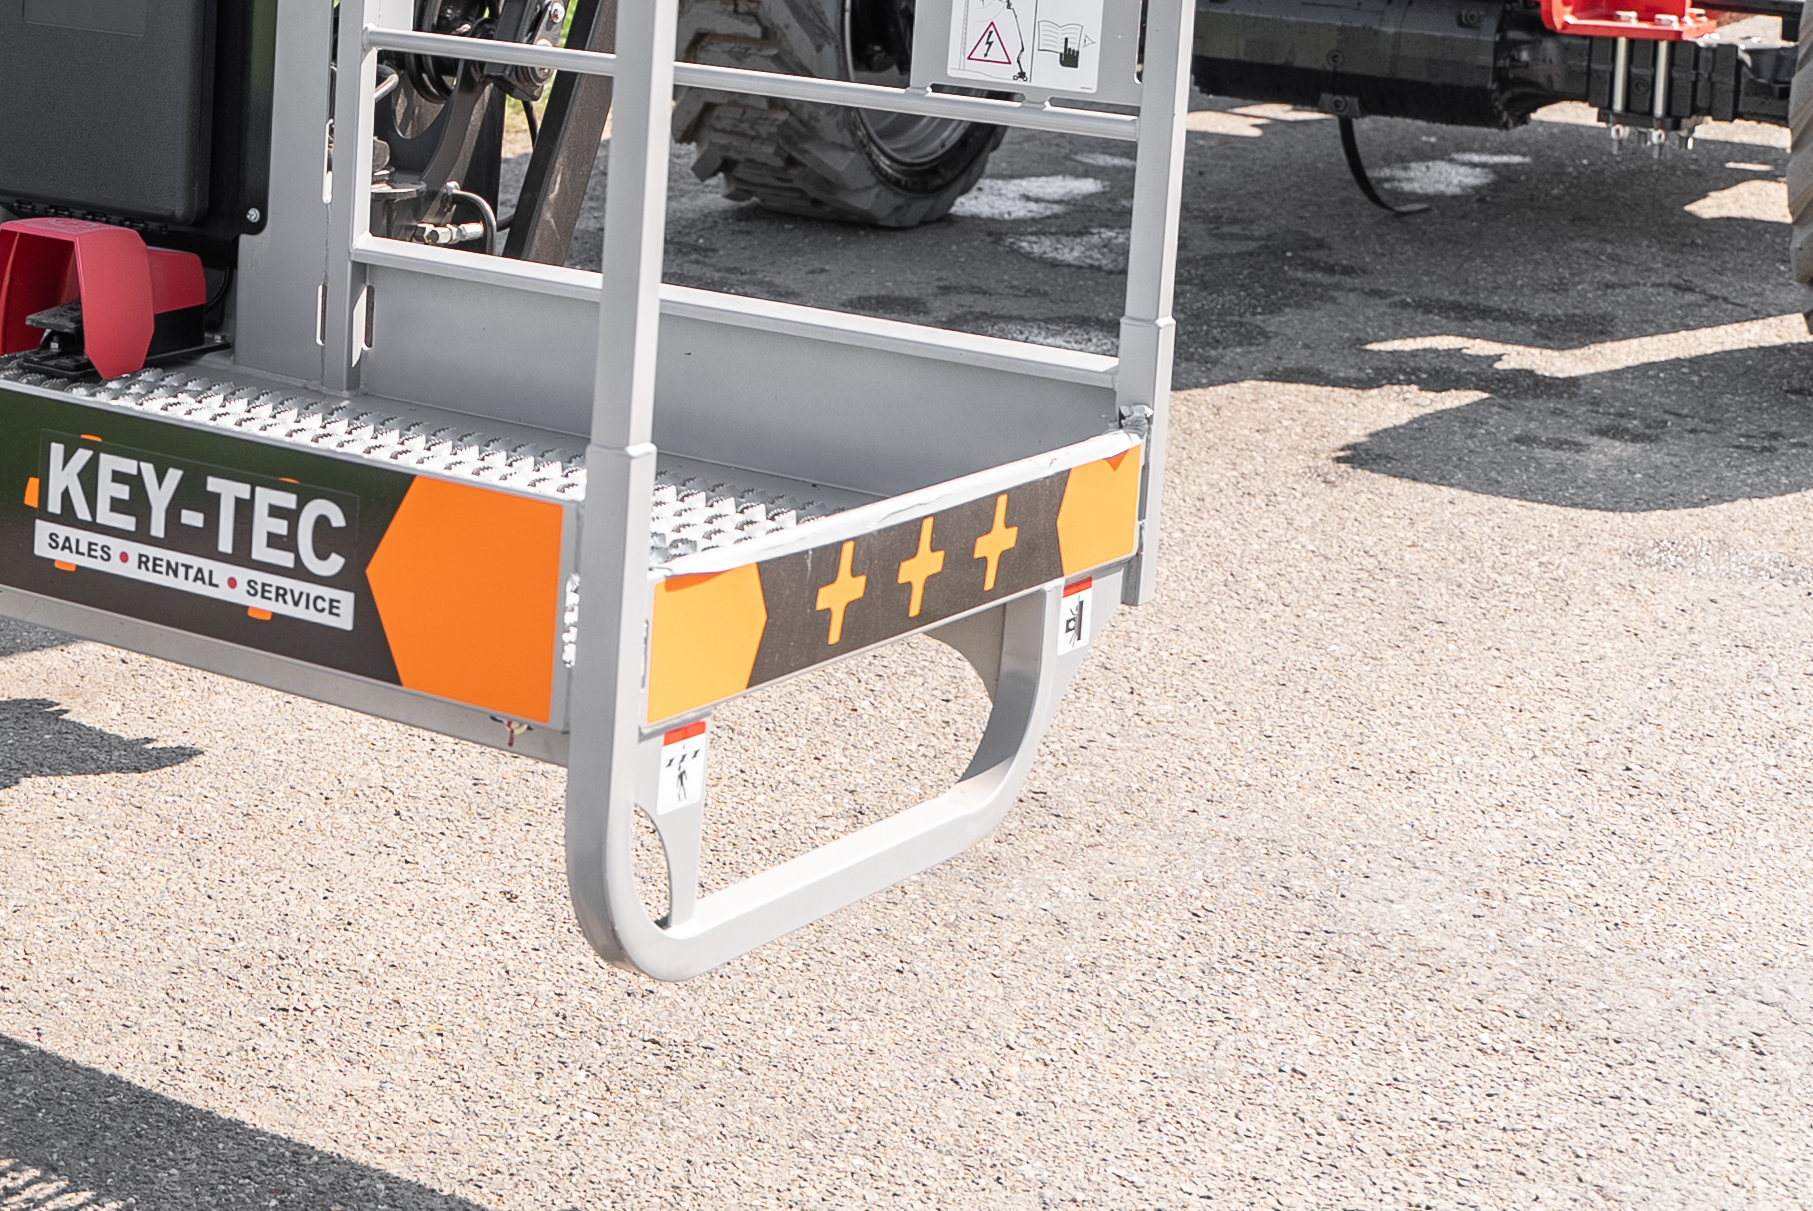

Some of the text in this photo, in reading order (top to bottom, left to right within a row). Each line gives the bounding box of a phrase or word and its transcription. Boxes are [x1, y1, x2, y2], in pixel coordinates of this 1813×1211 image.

[47, 441, 347, 577] KEY-TEC
[47, 532, 342, 618] SALES RENTAL SERVICE
